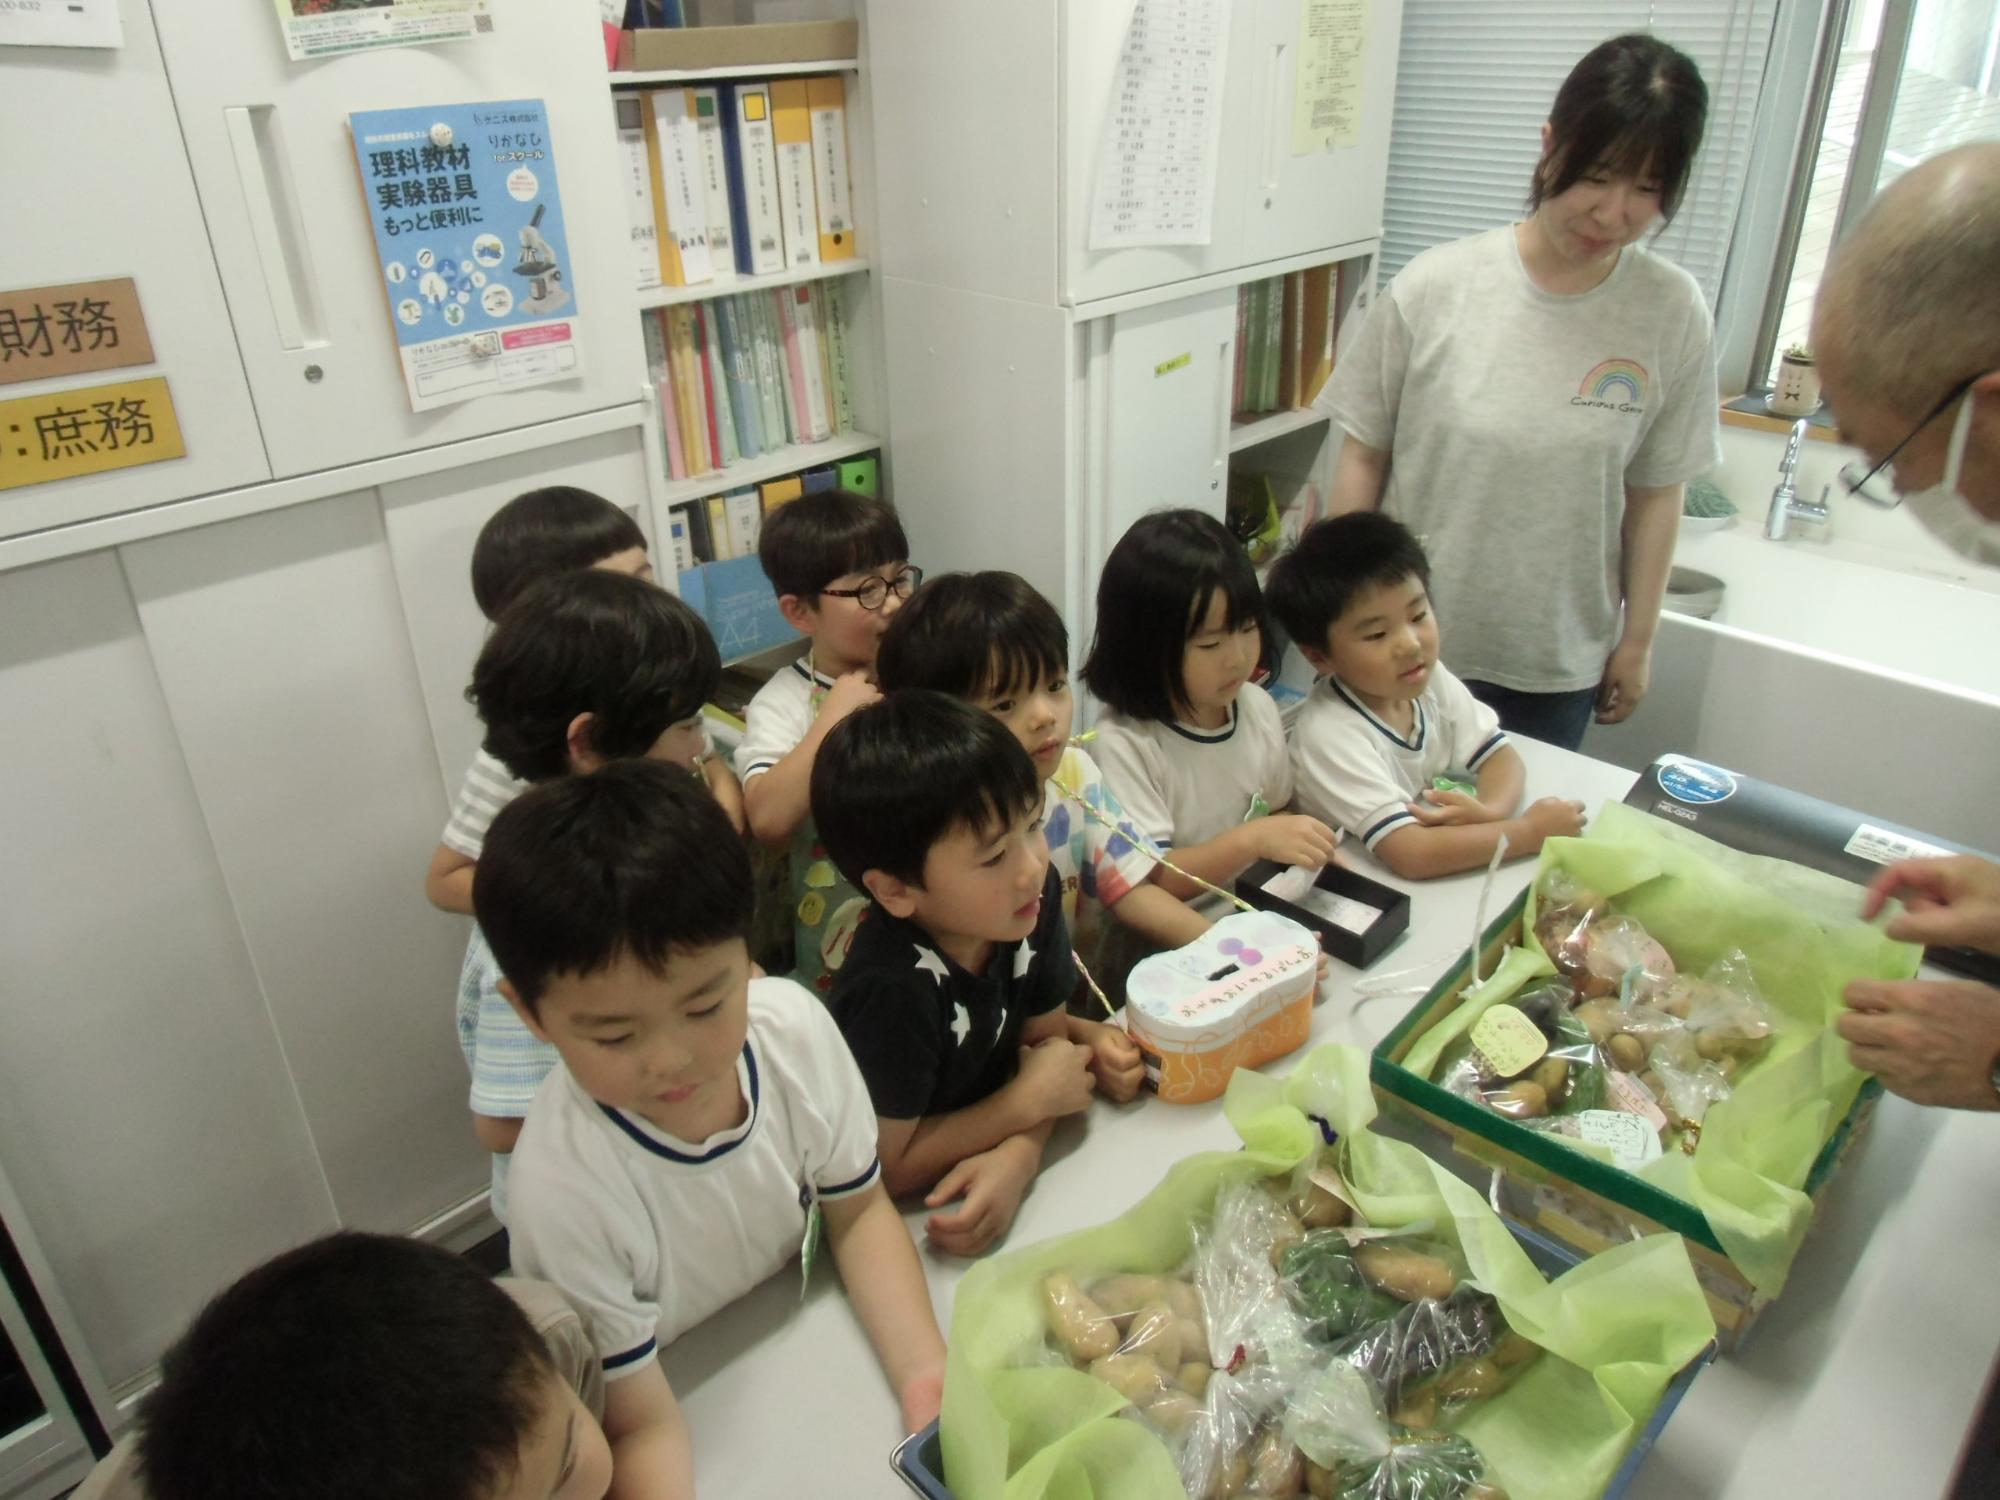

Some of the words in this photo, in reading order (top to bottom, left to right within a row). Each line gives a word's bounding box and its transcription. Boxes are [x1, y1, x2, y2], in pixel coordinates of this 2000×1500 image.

[369, 143, 470, 178] 理科教材
[376, 173, 478, 211] 実験器具
[384, 206, 484, 236] もっと便利に
[0, 298, 119, 362] 財務
[1570, 396, 1616, 410] Curious
